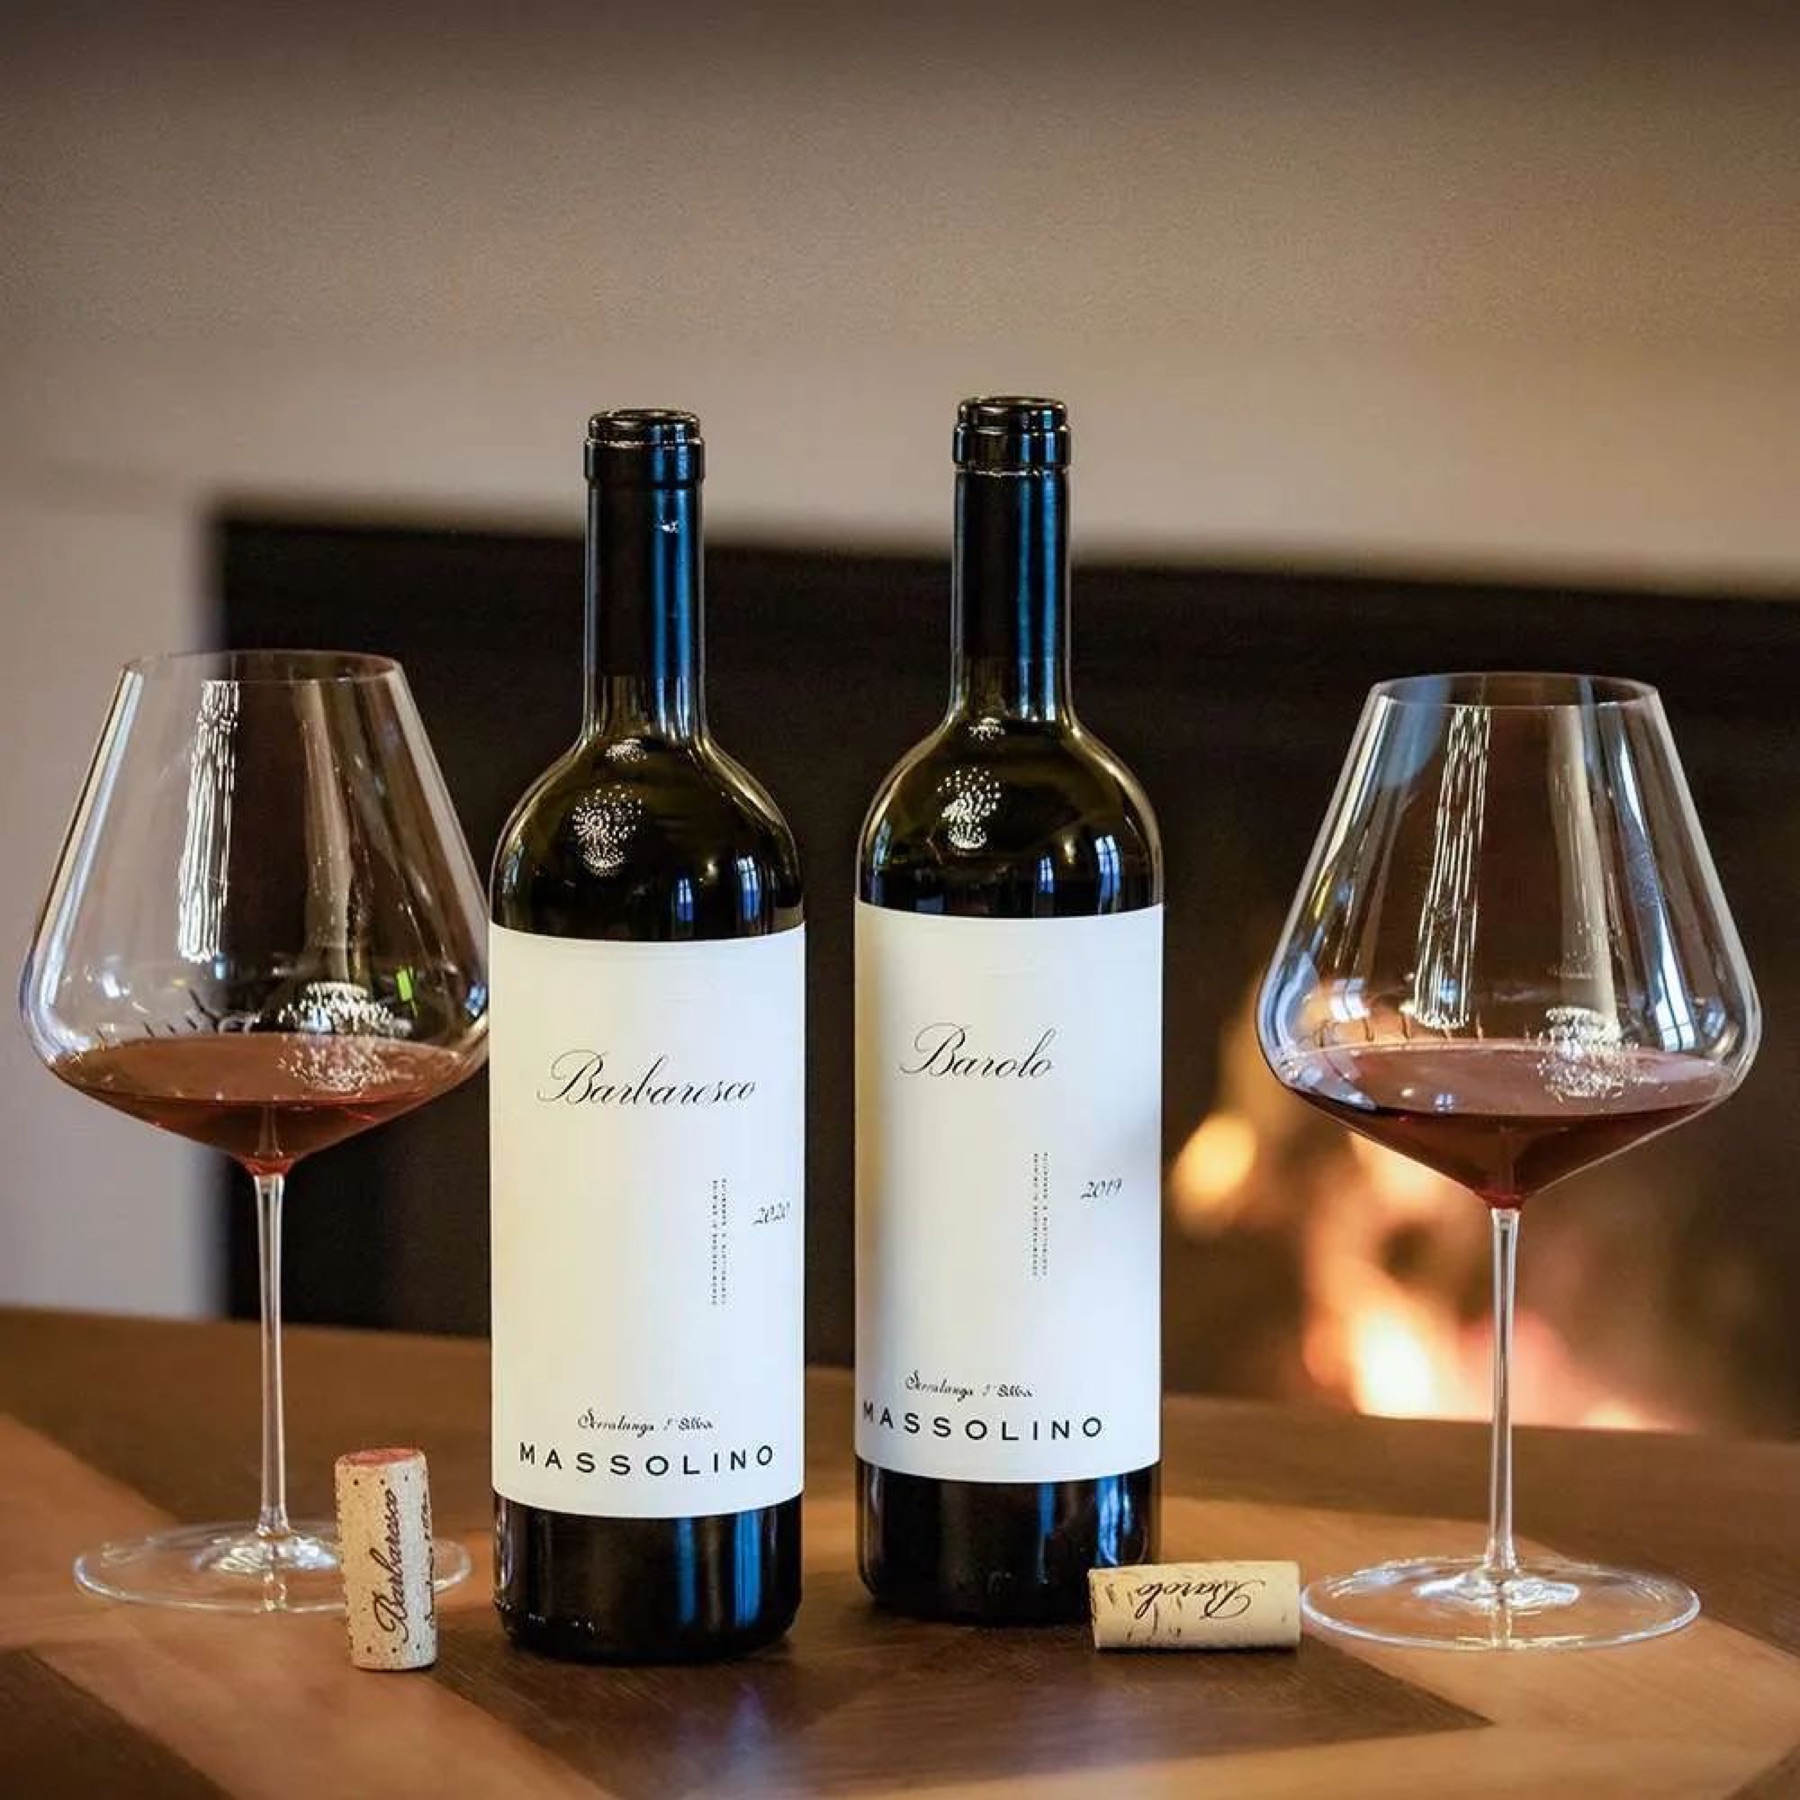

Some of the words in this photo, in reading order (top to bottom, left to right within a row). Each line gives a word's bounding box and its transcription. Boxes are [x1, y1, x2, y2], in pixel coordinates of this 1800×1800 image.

[899, 1022, 1056, 1078] Barolo
[536, 1049, 757, 1105] Barbaresco
[1080, 1178, 1122, 1199] 2019
[862, 1400, 1102, 1441] MASSOLINO
[519, 1442, 773, 1476] MASSOLINO
[369, 1488, 409, 1644] Barbaresco
[1134, 1579, 1266, 1619] Barolo
